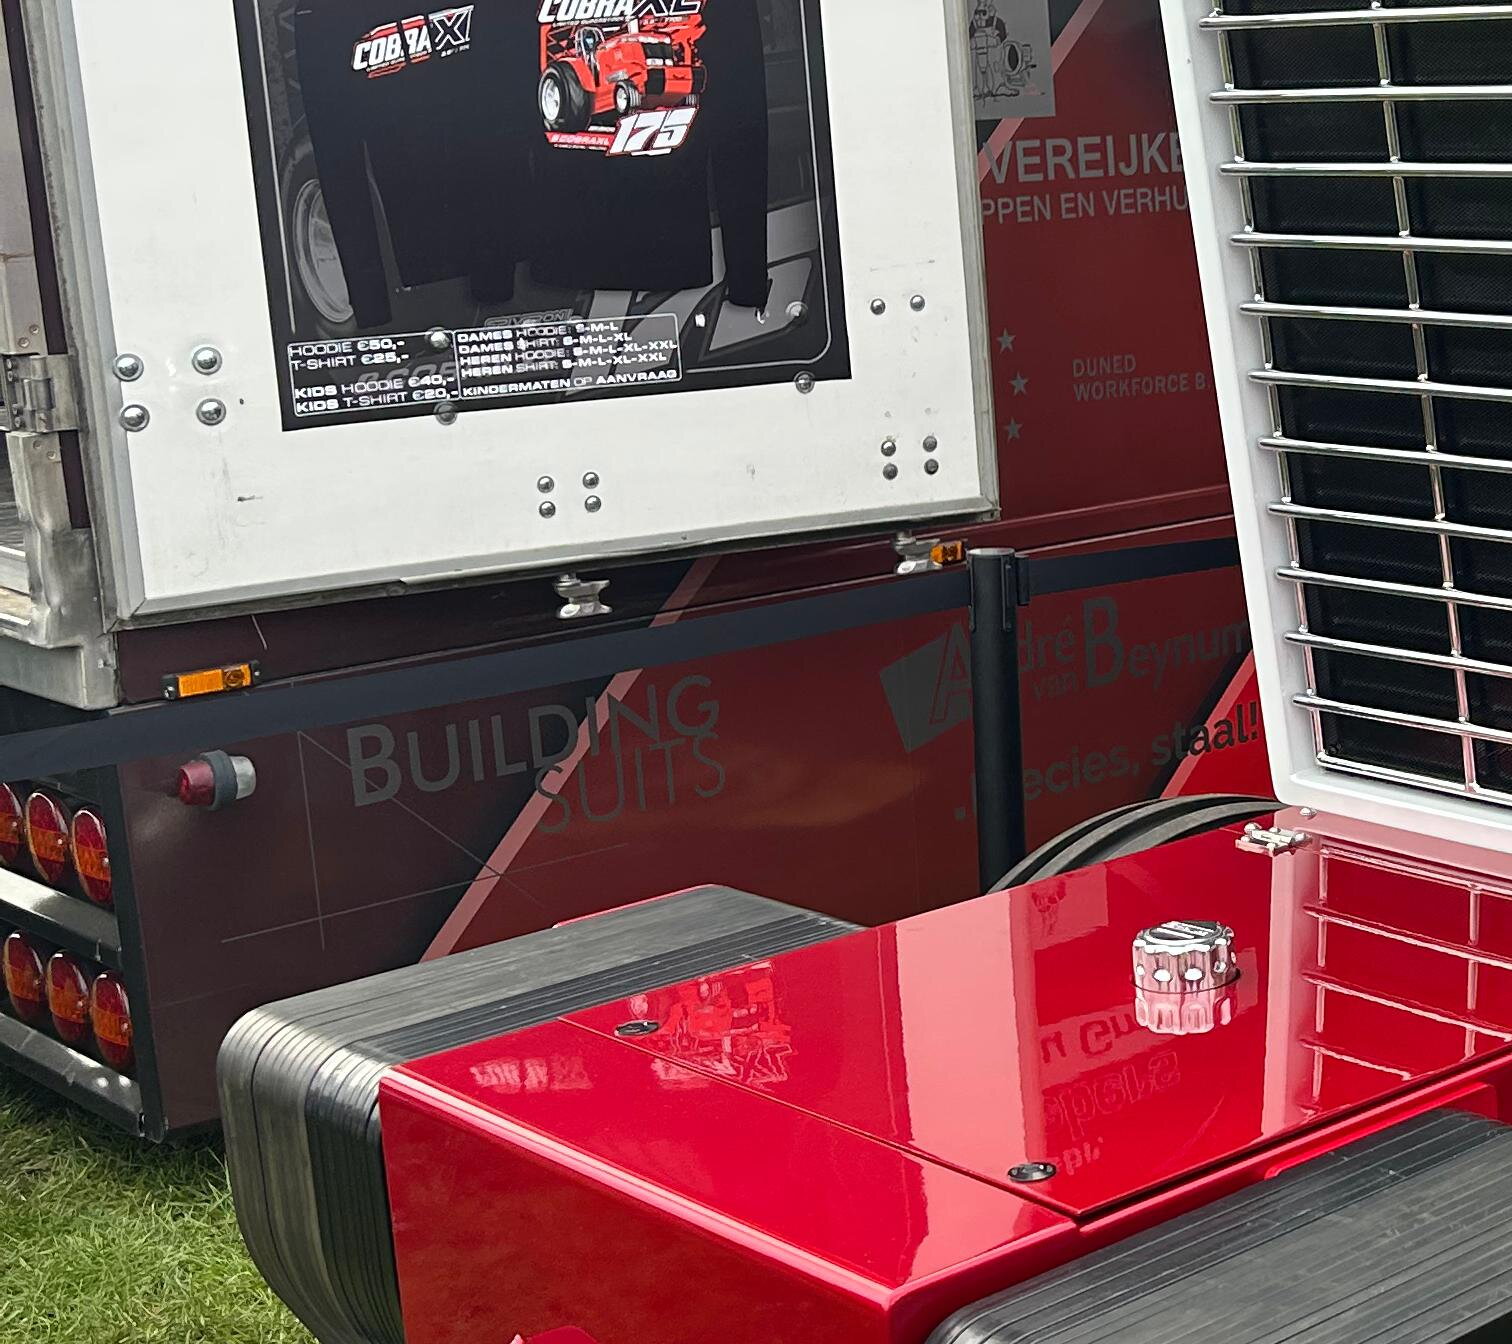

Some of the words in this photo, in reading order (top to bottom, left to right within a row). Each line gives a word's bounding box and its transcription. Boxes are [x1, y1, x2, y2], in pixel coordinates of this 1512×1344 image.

[610, 106, 699, 154] 175
[1060, 191, 1096, 221] EN
[456, 329, 514, 343] DAMES
[290, 341, 353, 357] HOODIE
[458, 341, 515, 355] DAMES
[290, 355, 357, 372] T-SHIRT
[459, 353, 513, 367] HEREN
[461, 364, 514, 379] HEREN
[1072, 354, 1137, 379] DUNED
[294, 384, 338, 400] KIDS
[341, 378, 405, 395] HOODIE
[1072, 372, 1190, 402] WORKFORCE
[296, 398, 340, 414] KIDS
[342, 391, 409, 408] T-SHIRT
[346, 674, 720, 809] BUILDING
[1151, 700, 1260, 768] staal!
[534, 731, 727, 834] SUITS
